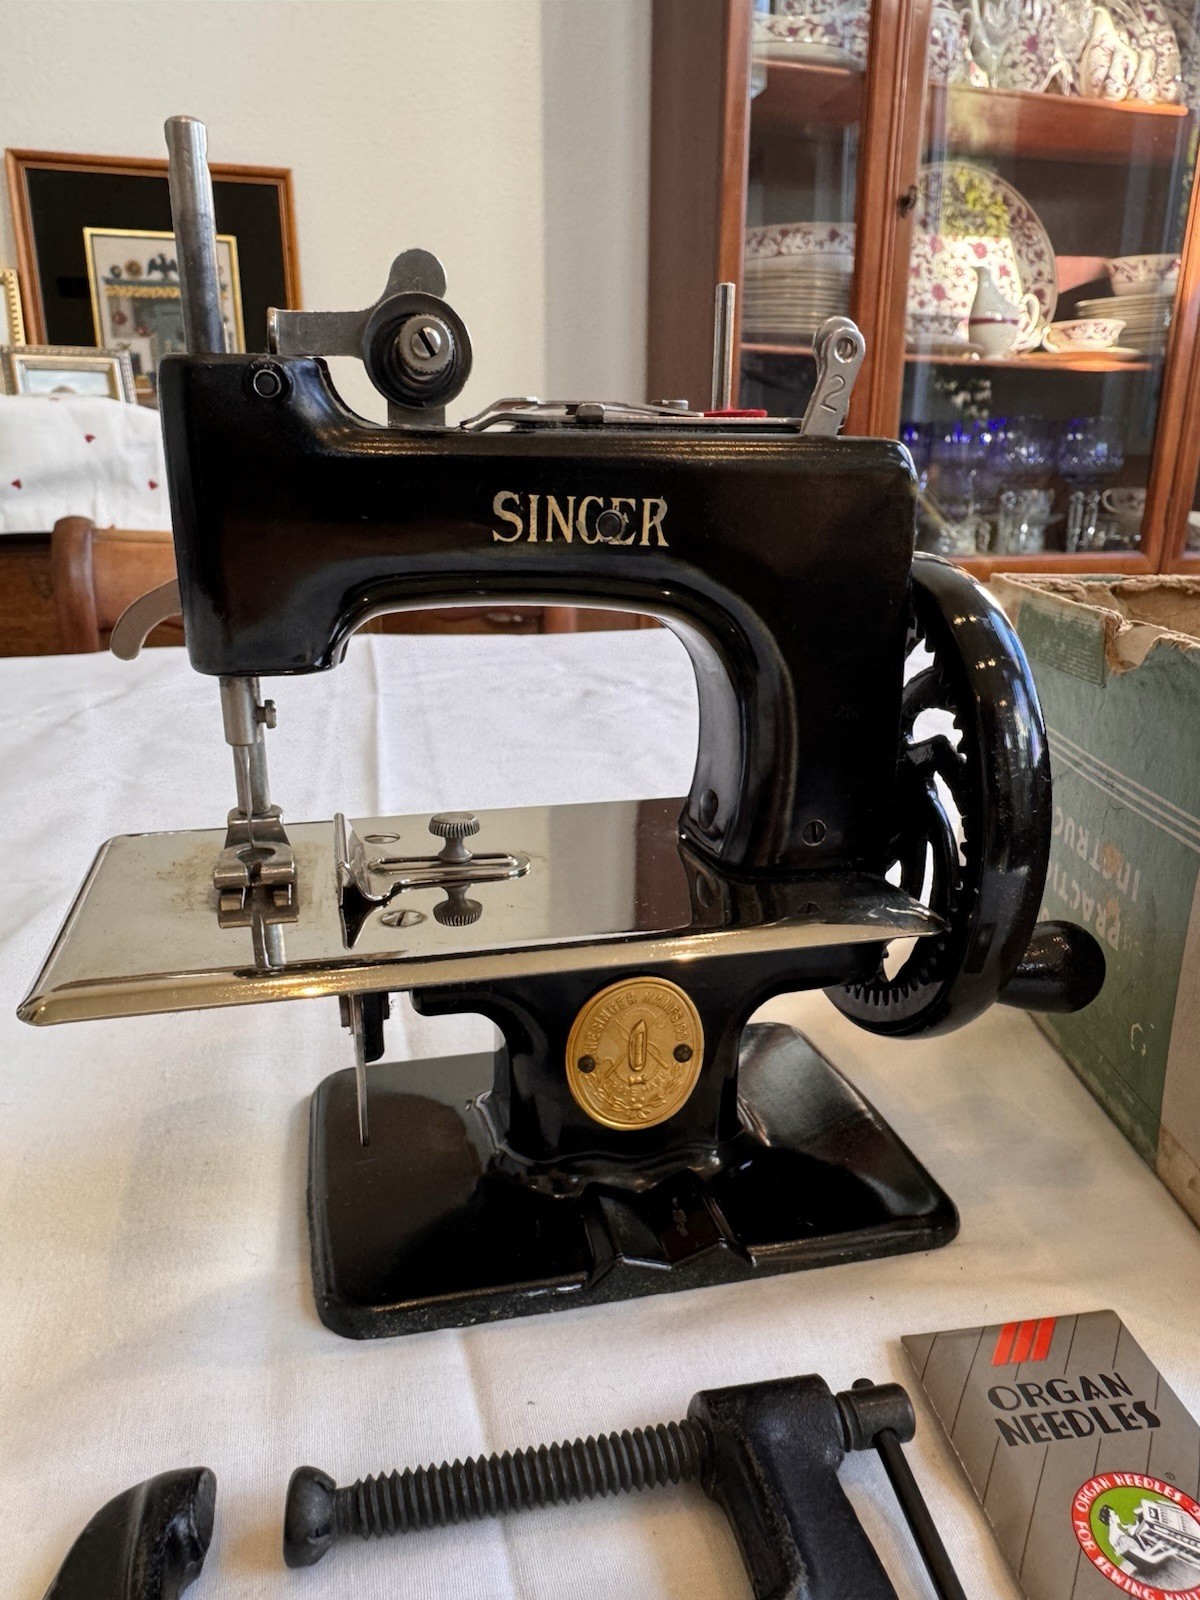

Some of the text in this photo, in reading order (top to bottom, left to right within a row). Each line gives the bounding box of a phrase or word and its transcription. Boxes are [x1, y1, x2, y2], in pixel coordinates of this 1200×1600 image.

[820, 375, 845, 413] 2
[492, 490, 670, 547] SINGER
[593, 992, 637, 1032] SINGER
[987, 1372, 1133, 1411] ORGAN
[994, 1401, 1161, 1447] NEEDLES
[1076, 1473, 1183, 1512] ORGAN NEEDLES
[1074, 1520, 1097, 1551] FOR
[1094, 1555, 1156, 1600] SEWING
